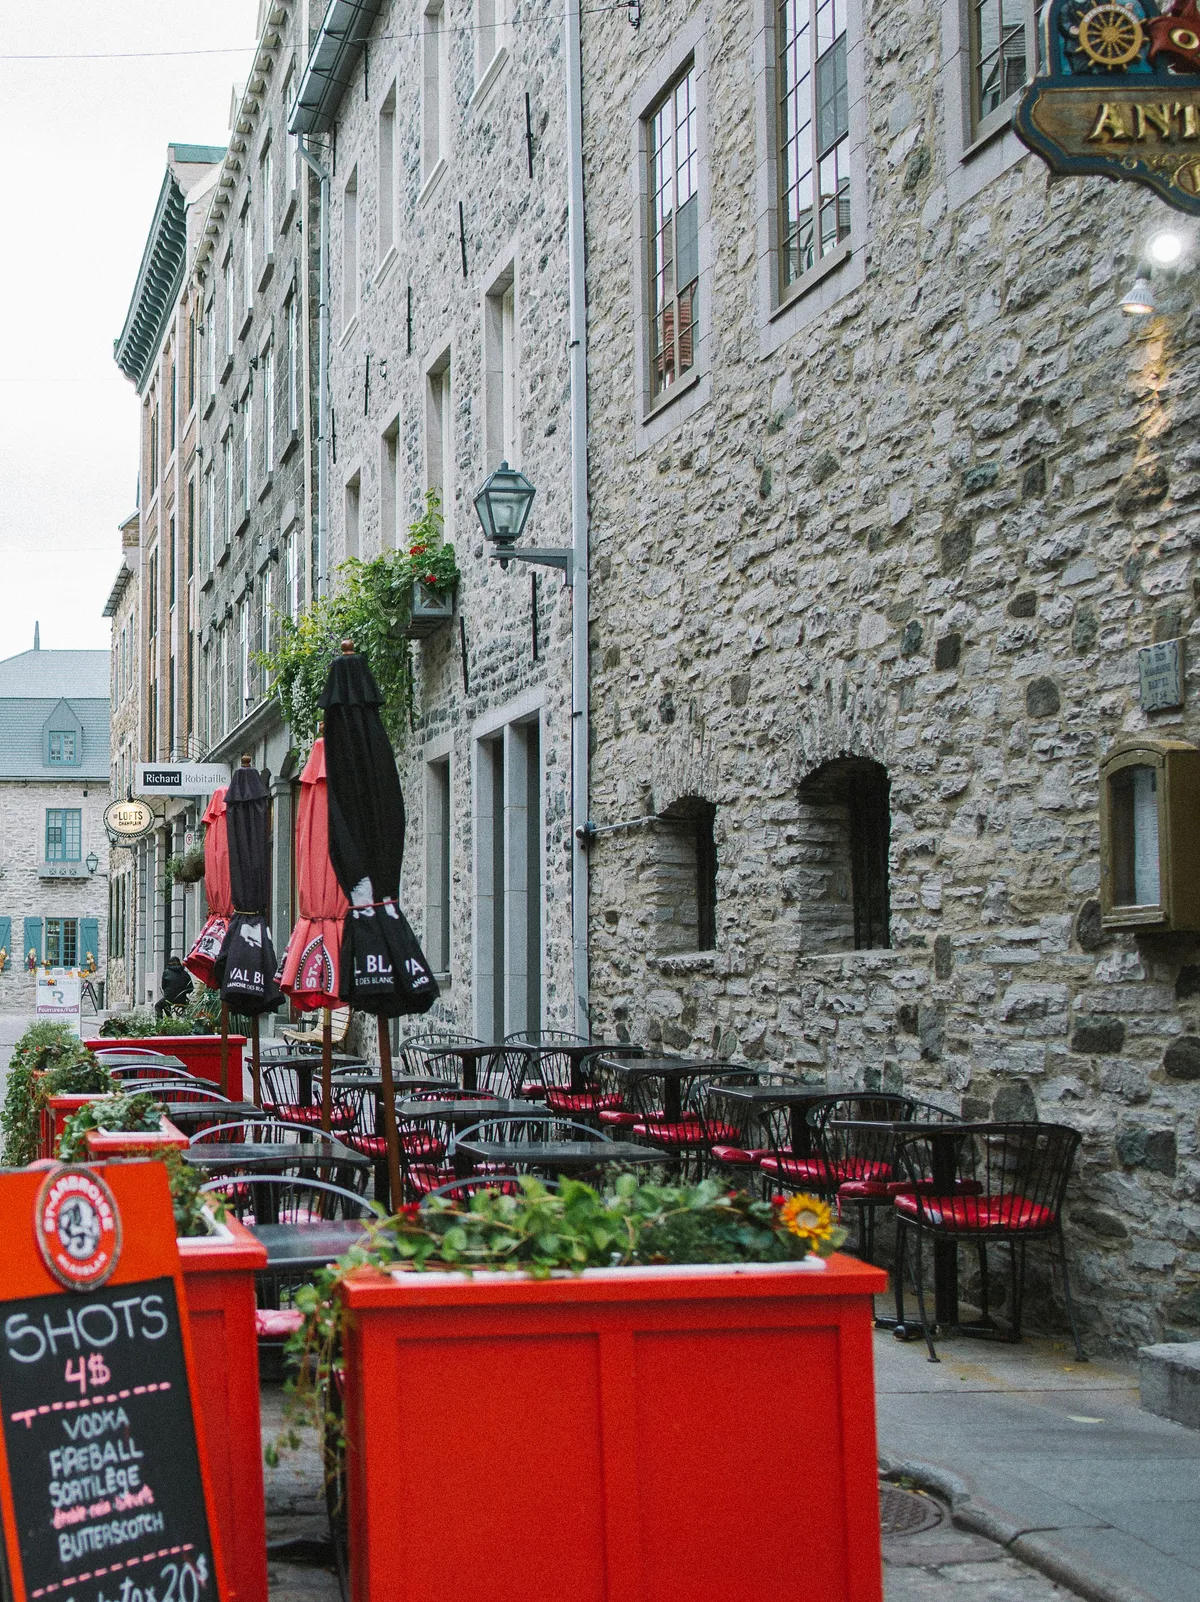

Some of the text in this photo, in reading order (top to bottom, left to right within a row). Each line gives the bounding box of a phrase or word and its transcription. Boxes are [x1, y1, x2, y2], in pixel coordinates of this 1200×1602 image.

[145, 773, 226, 783] Richard Robitaille
[118, 811, 143, 821] LOFTS
[4, 1294, 169, 1364] SHOTS
[64, 1352, 112, 1394] 4$
[62, 1406, 130, 1441] VODKA
